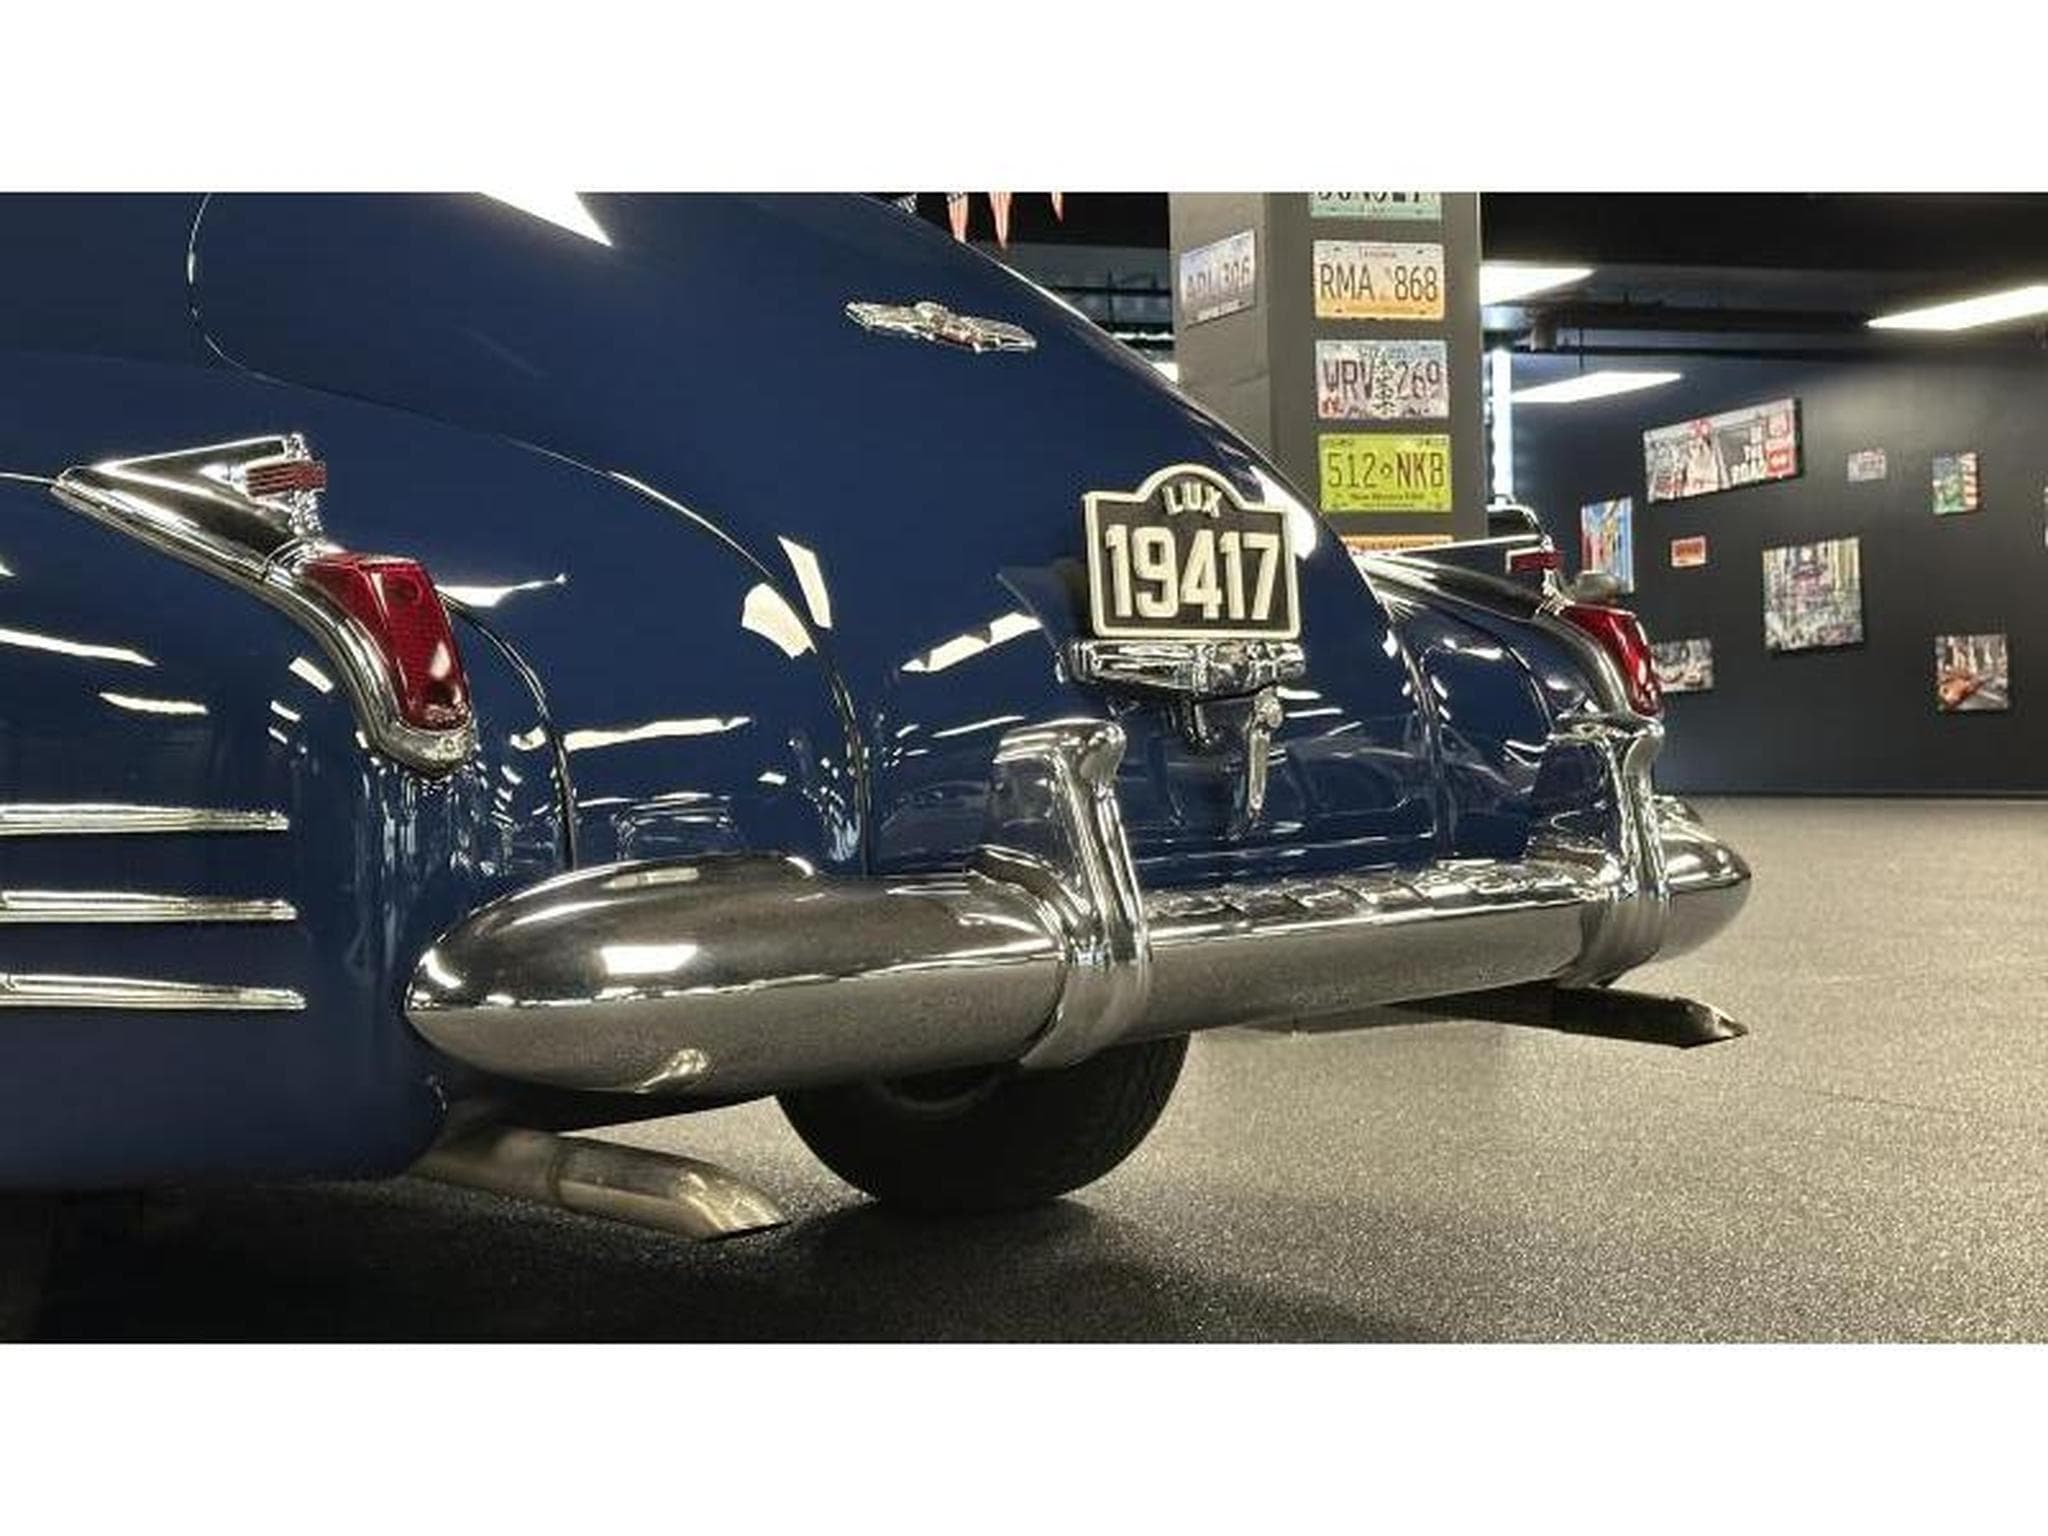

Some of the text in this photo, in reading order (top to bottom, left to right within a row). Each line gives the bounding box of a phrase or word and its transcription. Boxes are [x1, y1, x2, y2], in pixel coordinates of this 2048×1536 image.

[1320, 263, 1438, 302] RMA 868
[1323, 359, 1441, 400] WRV 269
[1328, 452, 1377, 488] 512
[1162, 482, 1222, 518] LUX
[1105, 524, 1280, 621] 19417
